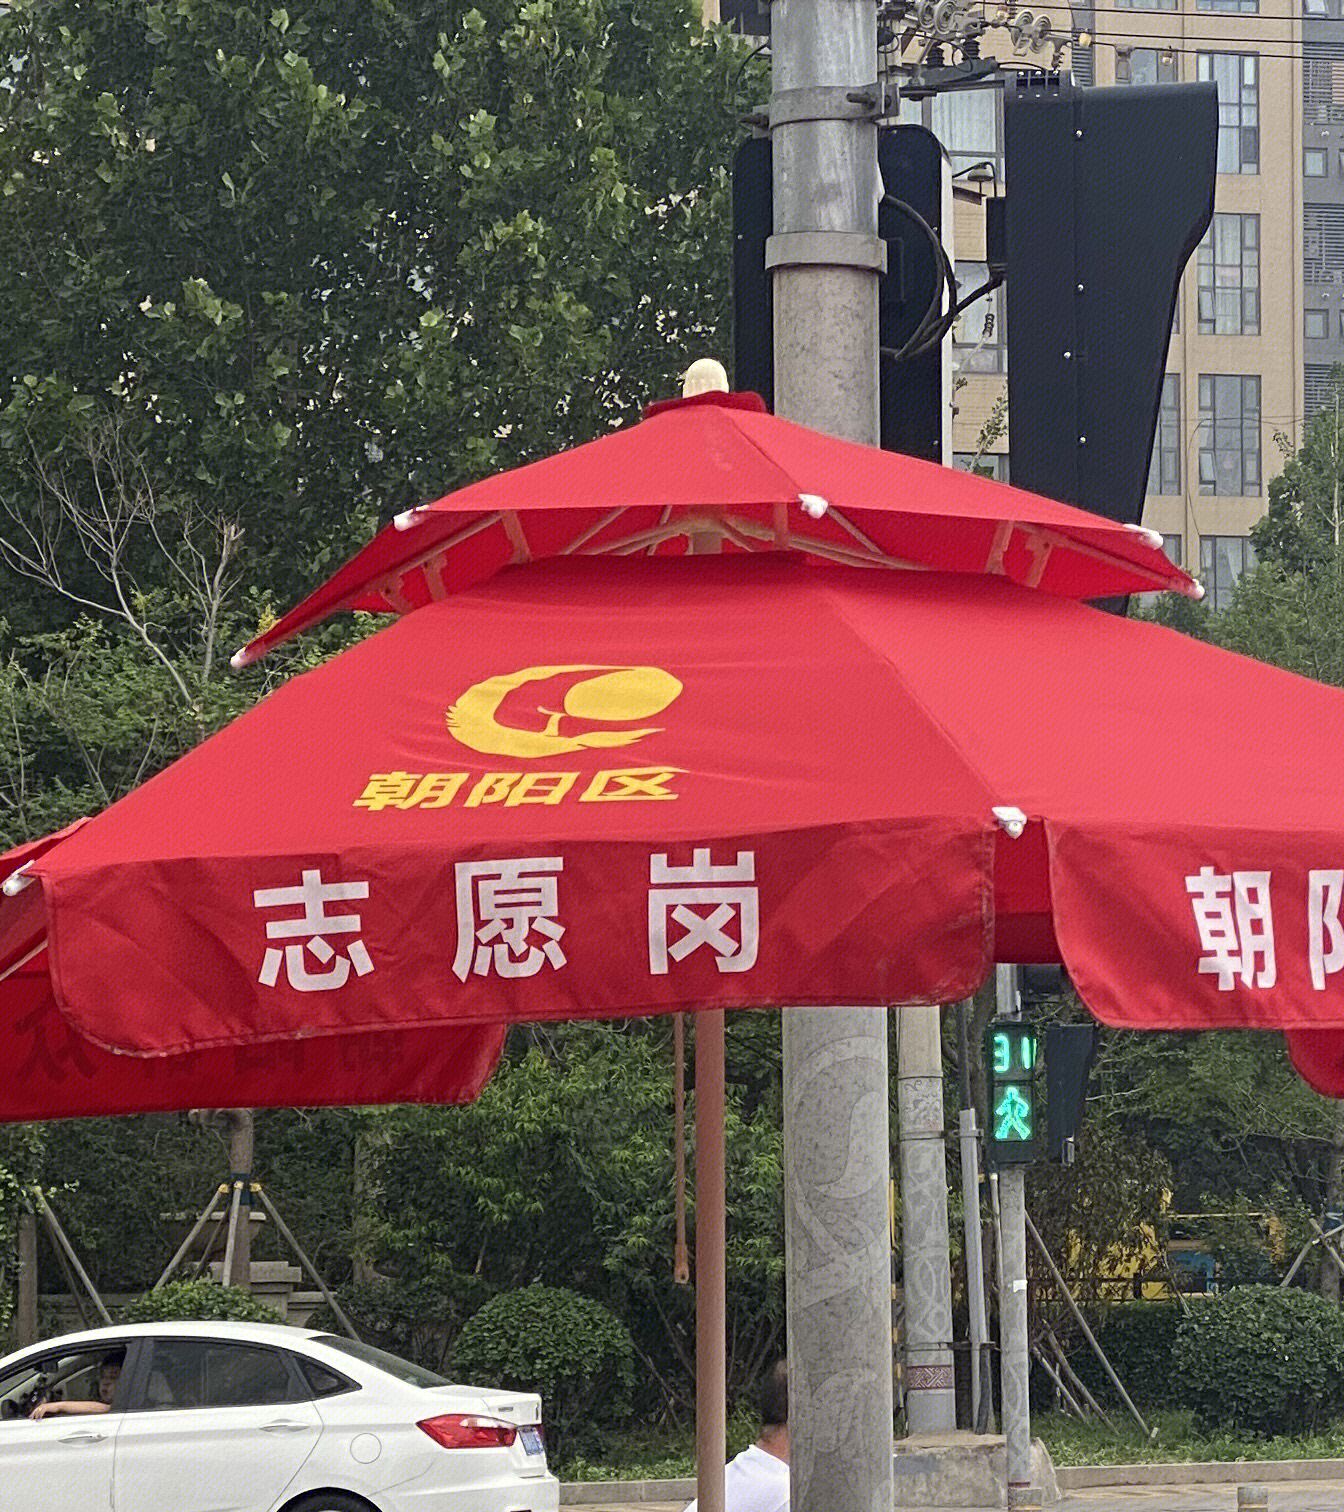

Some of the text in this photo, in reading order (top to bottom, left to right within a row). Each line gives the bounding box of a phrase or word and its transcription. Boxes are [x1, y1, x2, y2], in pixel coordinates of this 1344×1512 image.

[353, 766, 690, 811] 朝阳区
[253, 847, 760, 992] 志愿岗
[993, 1033, 1032, 1073] 31
